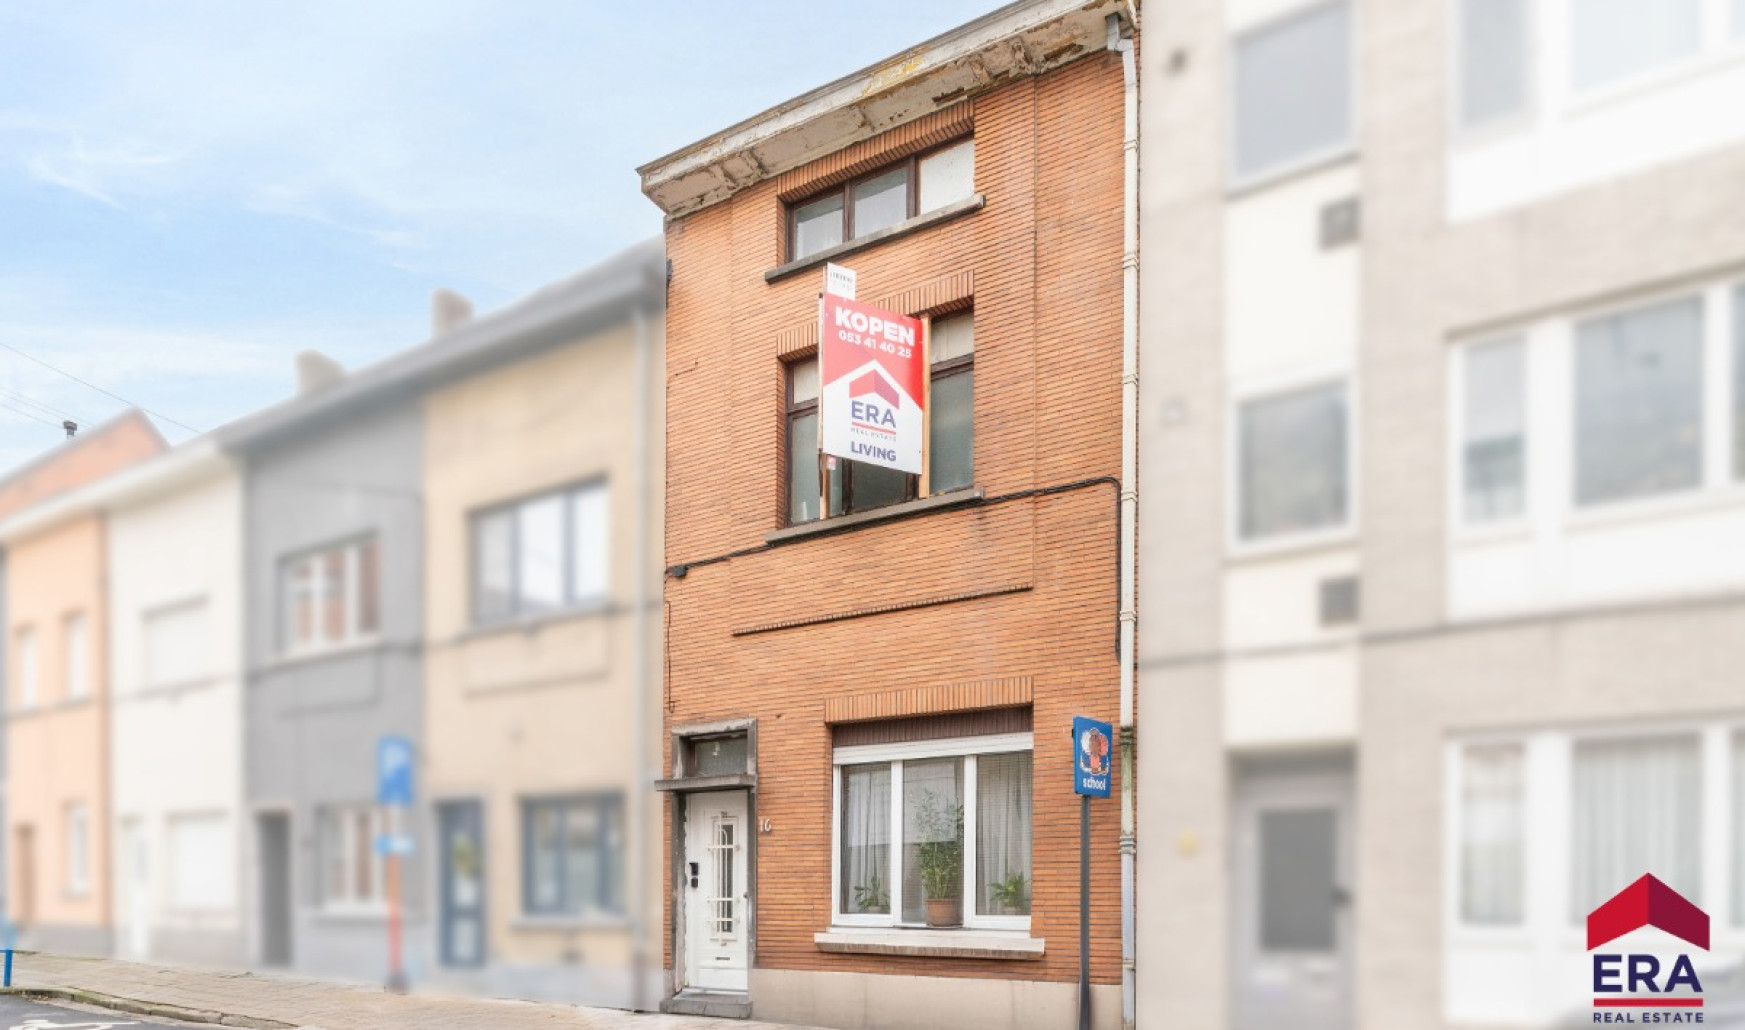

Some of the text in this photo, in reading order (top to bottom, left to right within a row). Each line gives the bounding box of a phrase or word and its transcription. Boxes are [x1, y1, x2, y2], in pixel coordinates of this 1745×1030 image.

[835, 306, 915, 347] KOPEN
[838, 330, 912, 359] 053 41 40 25
[851, 400, 896, 428] ERA
[851, 441, 897, 462] LIVING
[1082, 777, 1106, 791] school
[760, 818, 772, 832] 16
